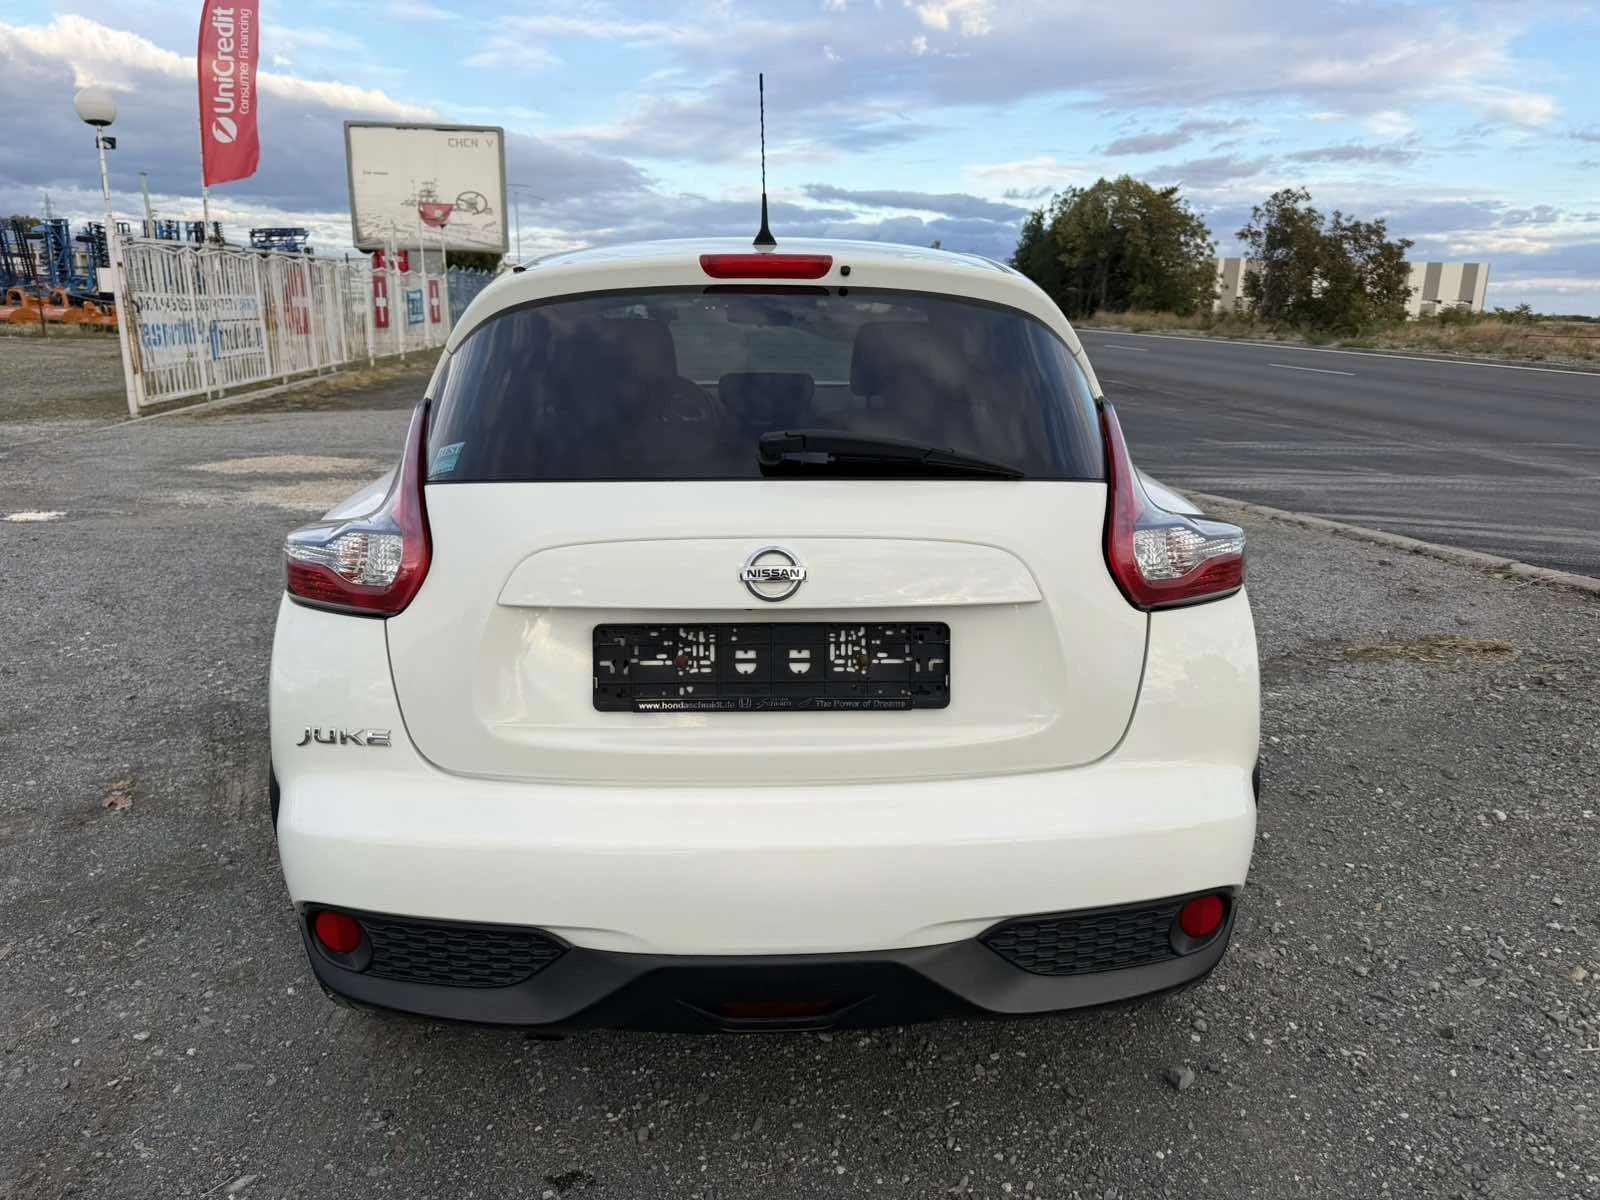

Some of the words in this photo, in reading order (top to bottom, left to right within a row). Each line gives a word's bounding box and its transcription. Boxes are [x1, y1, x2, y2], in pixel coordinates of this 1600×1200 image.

[238, 8, 253, 59] Financing
[212, 6, 235, 114] UniCredit
[239, 61, 250, 115] Consumer
[746, 568, 800, 578] NISSAN
[815, 699, 832, 708] The
[296, 727, 392, 748] JUKE
